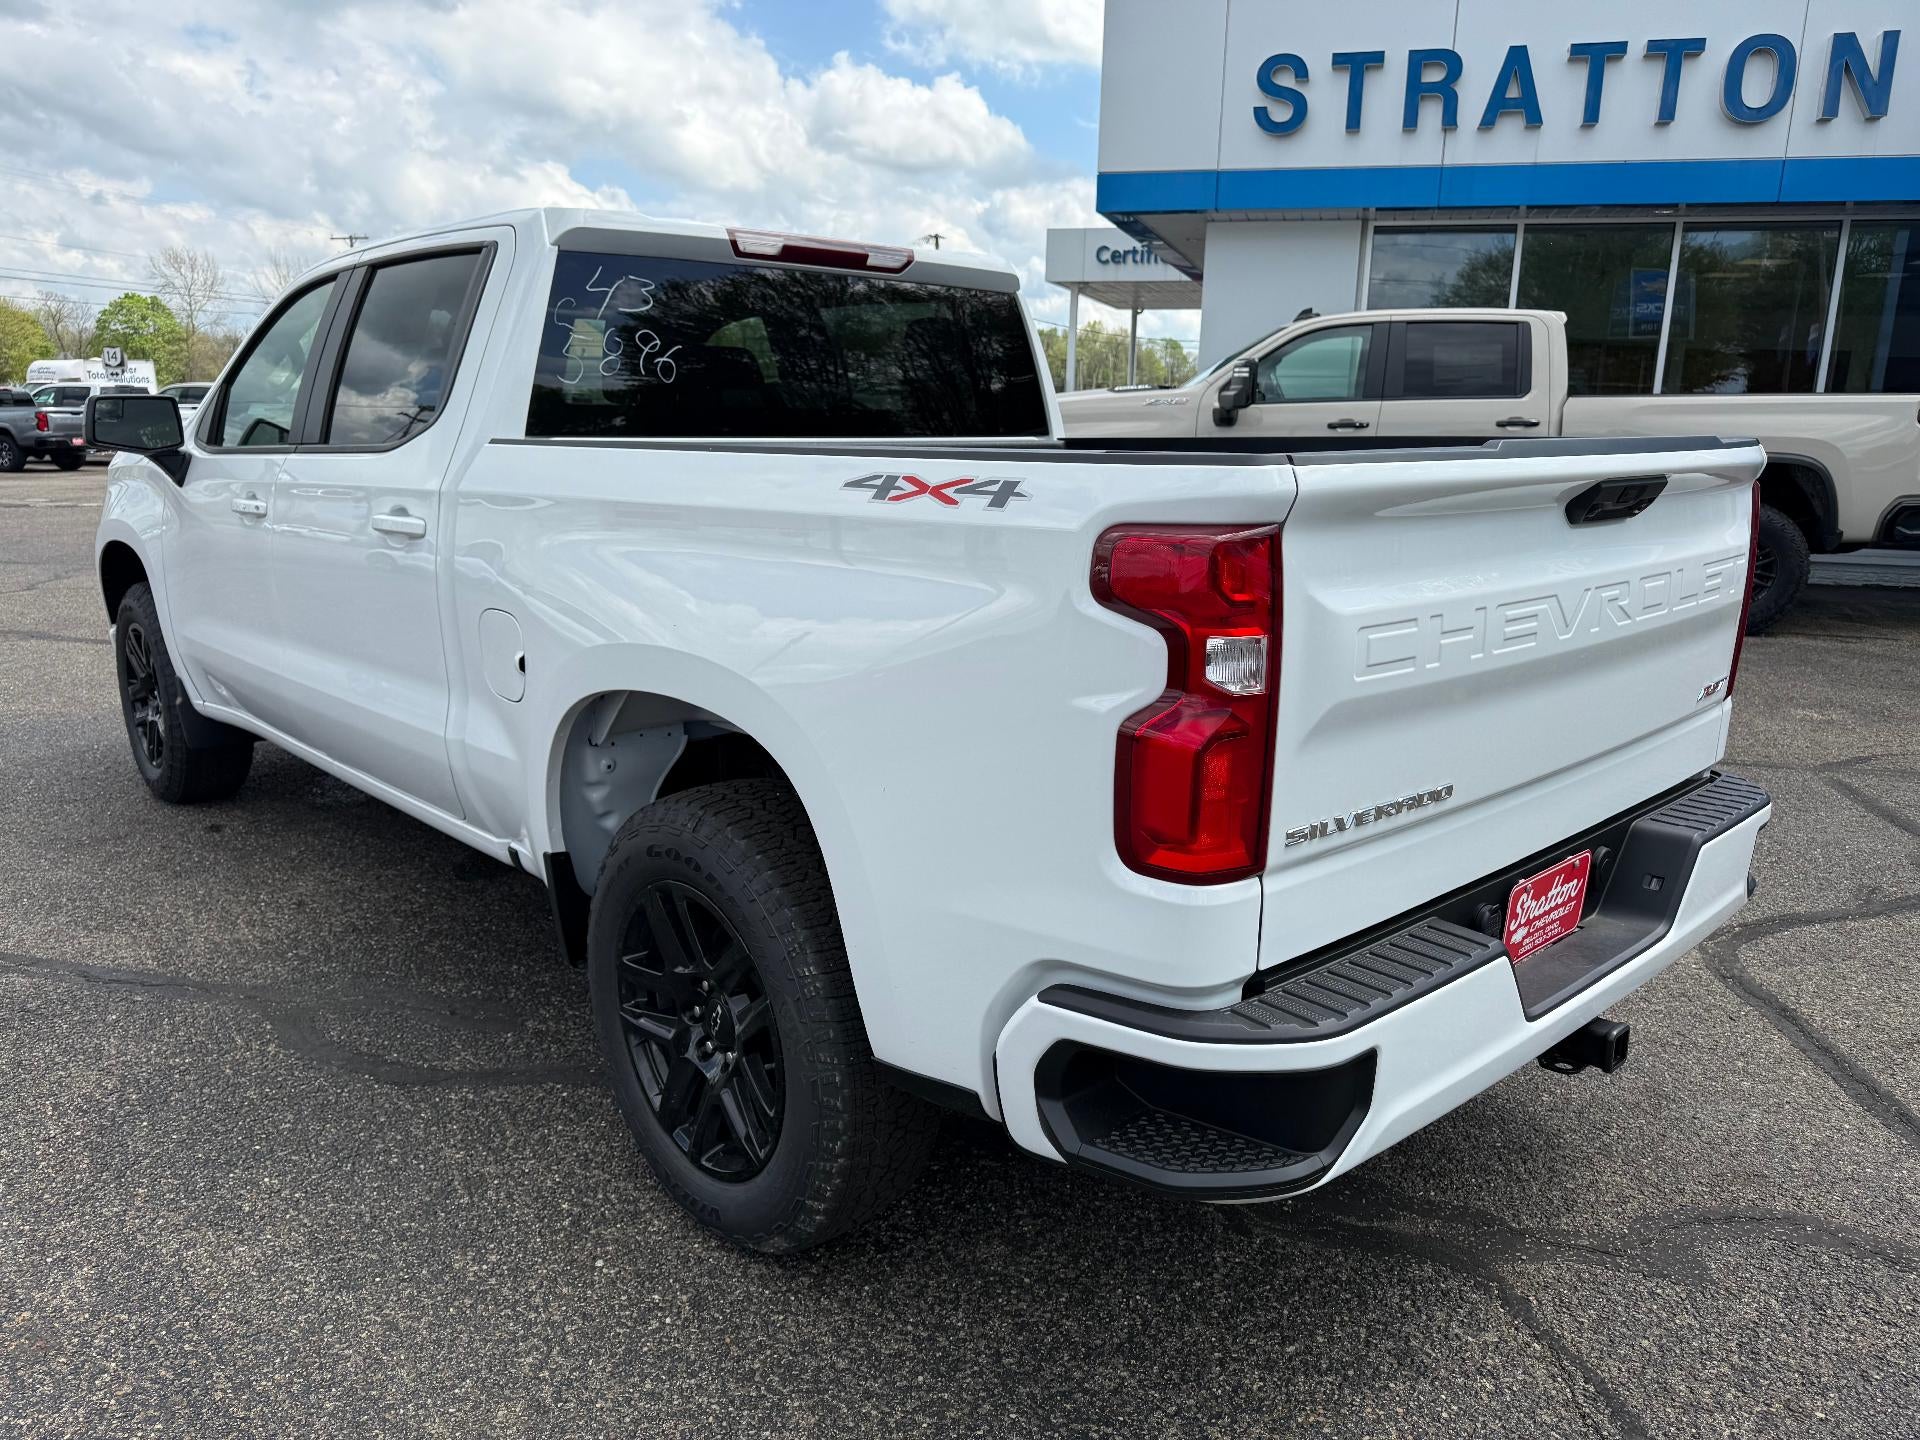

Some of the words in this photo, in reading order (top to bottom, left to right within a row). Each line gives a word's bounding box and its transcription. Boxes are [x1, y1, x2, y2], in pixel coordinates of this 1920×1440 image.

[1253, 30, 1901, 136] STRATTON
[586, 266, 655, 320] 43
[106, 350, 118, 362] 14
[1354, 554, 1746, 682] CHEVROLET
[1284, 783, 1454, 848] SILVERADO
[1509, 874, 1583, 931] Stratton
[1530, 900, 1577, 933] CHEVROLET
